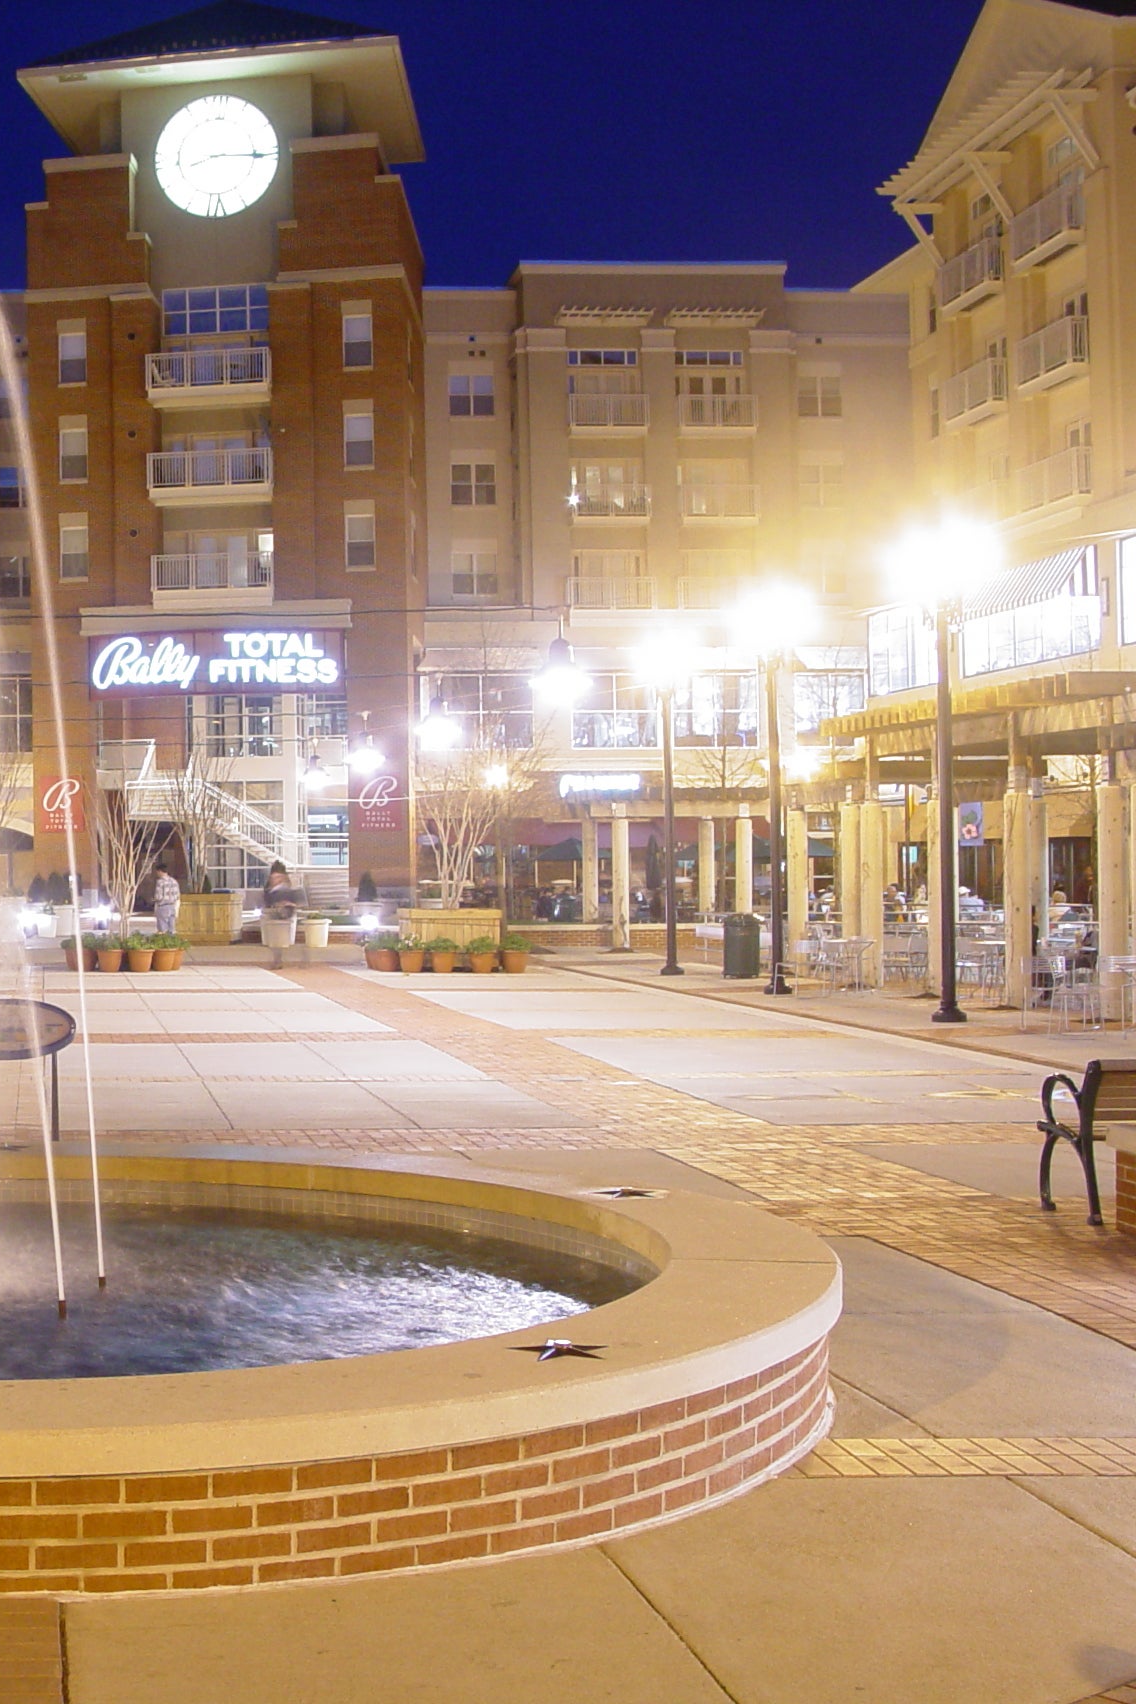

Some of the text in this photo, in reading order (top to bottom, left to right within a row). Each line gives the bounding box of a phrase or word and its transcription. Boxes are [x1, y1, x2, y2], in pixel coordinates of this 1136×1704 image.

[223, 633, 324, 658] TOTAL
[92, 637, 200, 689] Bally
[209, 658, 338, 684] FITNESS
